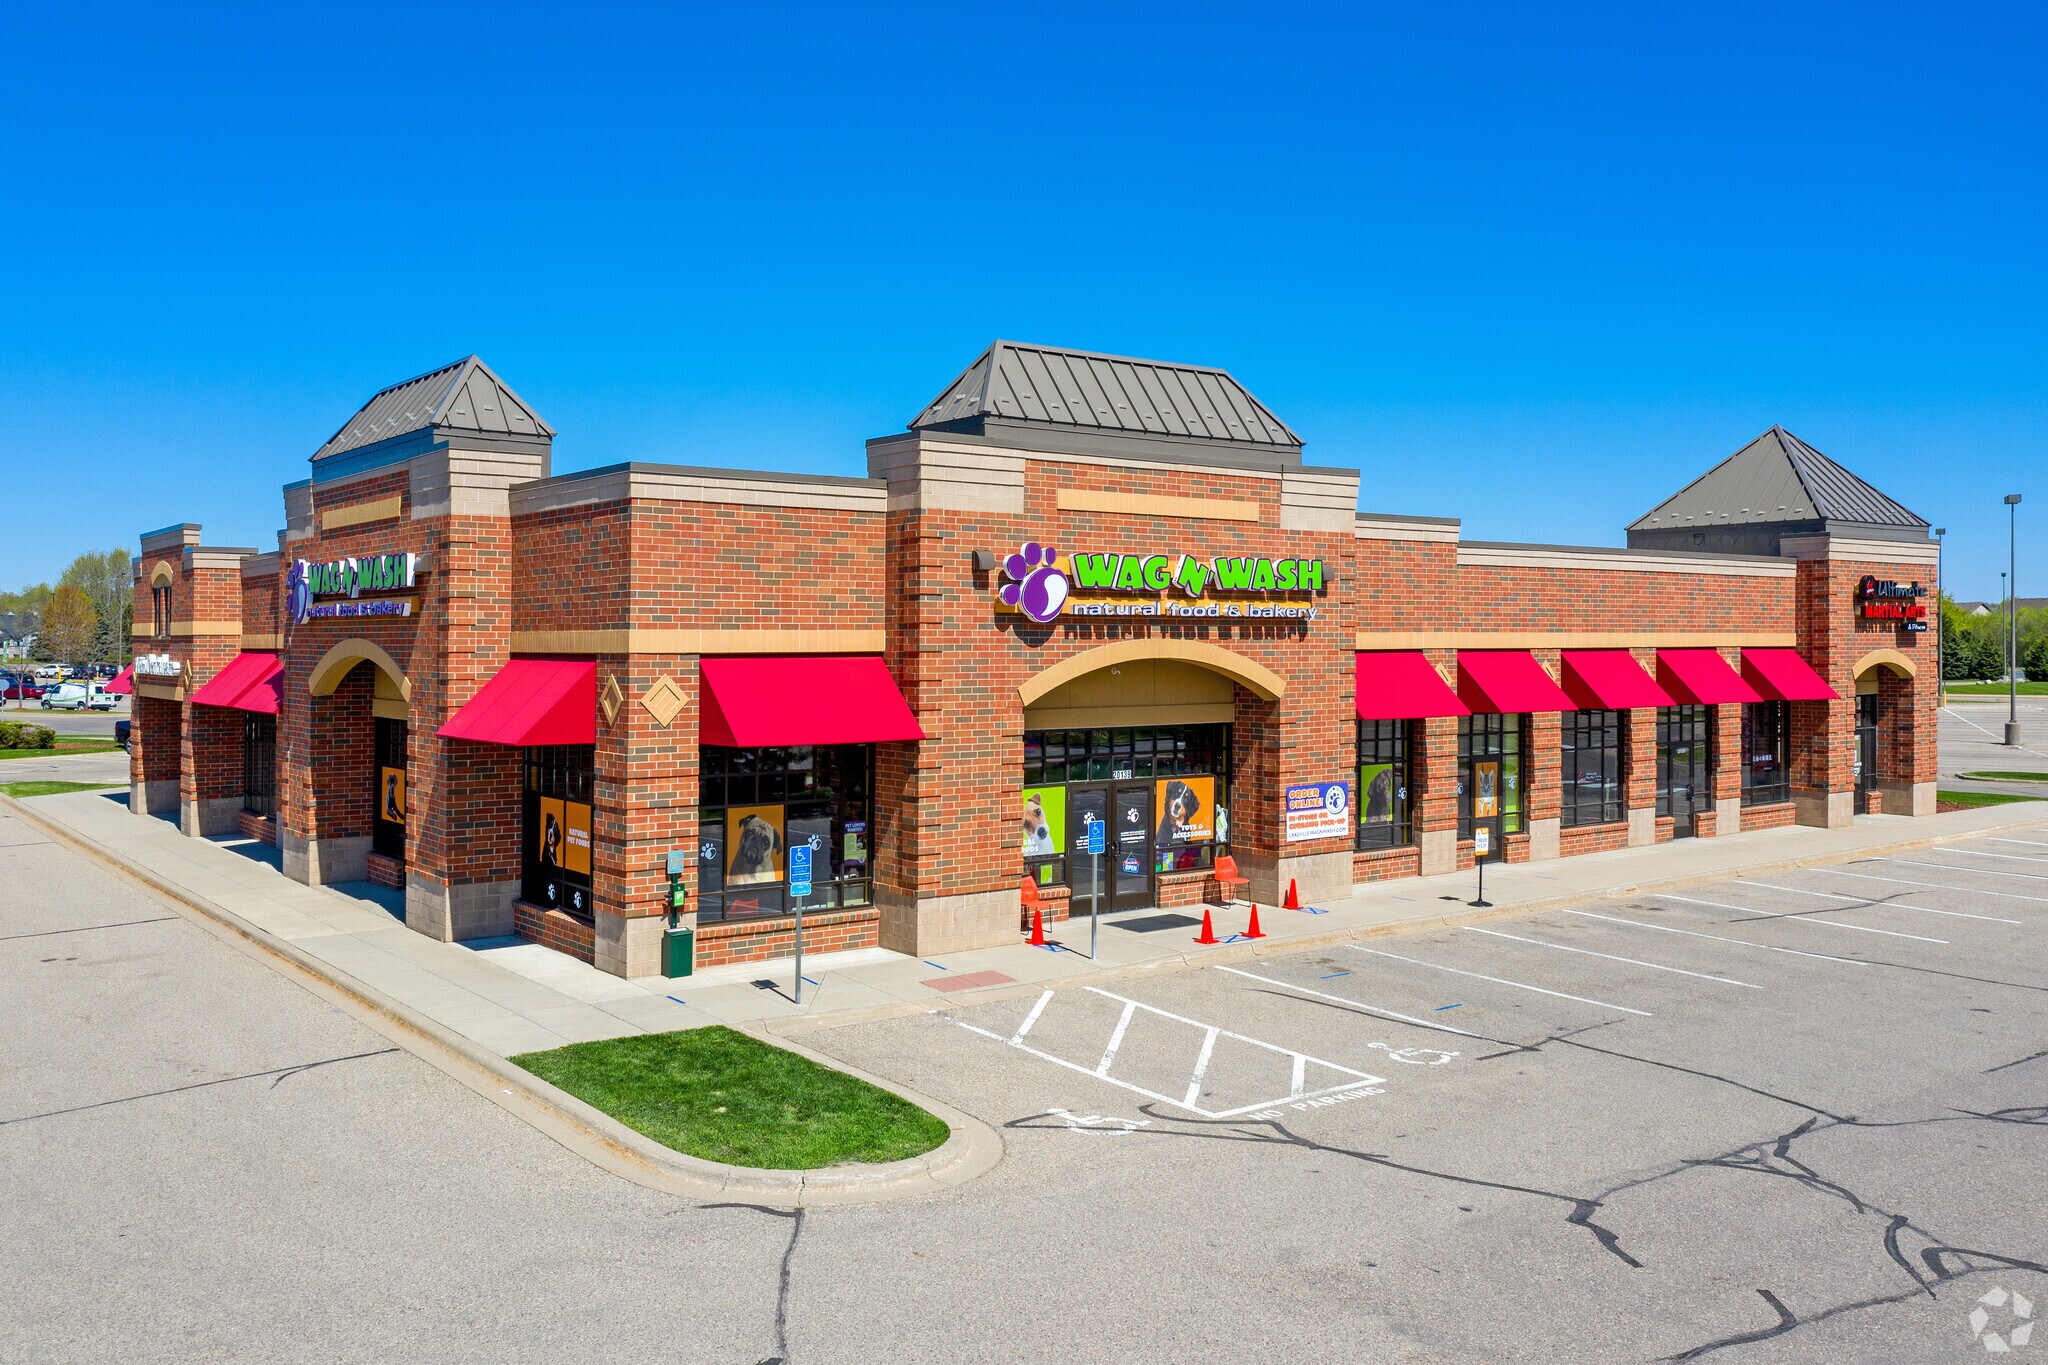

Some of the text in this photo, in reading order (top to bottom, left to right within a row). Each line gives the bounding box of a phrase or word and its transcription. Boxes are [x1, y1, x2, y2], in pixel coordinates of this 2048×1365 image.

[307, 561, 341, 594] WAG
[357, 552, 408, 590] WASH
[1071, 553, 1172, 590] WAG
[1211, 556, 1323, 591] WASH
[1878, 580, 1929, 597] Ultimate
[339, 602, 359, 617] food
[1072, 601, 1318, 621] natural food & bakery
[1865, 604, 1927, 618] MARTIAL ARTS
[1289, 788, 1320, 799] ORDER
[569, 828, 588, 839] NATURAL
[1172, 829, 1212, 839] ACCESSORIES
[1181, 824, 1197, 832] TOYS
[567, 836, 590, 848] PET FOODS
[1247, 1086, 1386, 1121] NO PARKING
